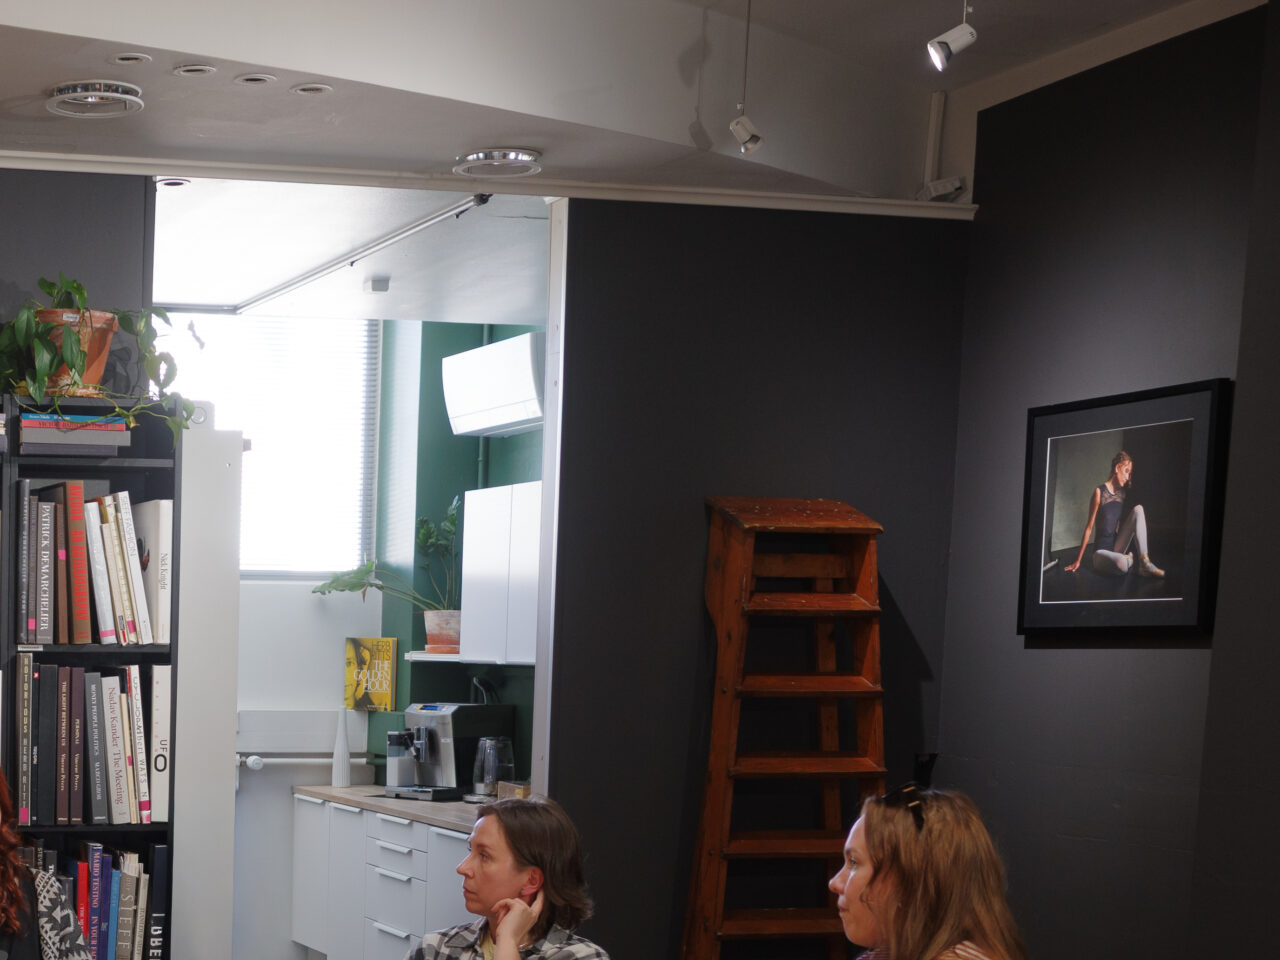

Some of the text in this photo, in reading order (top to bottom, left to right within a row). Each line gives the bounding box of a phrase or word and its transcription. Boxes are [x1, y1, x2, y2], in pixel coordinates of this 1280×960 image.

[69, 485, 88, 620] AVEDON AN AUTOBIOGRAPHY
[125, 518, 137, 557] FASHION
[40, 505, 51, 630] PATRICK DEMARCHELIER
[159, 553, 168, 590] Nick Knight
[354, 670, 390, 680] GOLDEN
[363, 680, 389, 692] HOUR
[90, 684, 98, 704] MONEY
[61, 737, 66, 746] US
[107, 687, 124, 805] Nadav Kander The Meeting
[154, 739, 167, 772] UFO
[92, 851, 100, 876] MARIO
[92, 878, 100, 908] TESTINO
[91, 916, 98, 924] IN
[118, 895, 134, 949] SIEFF
